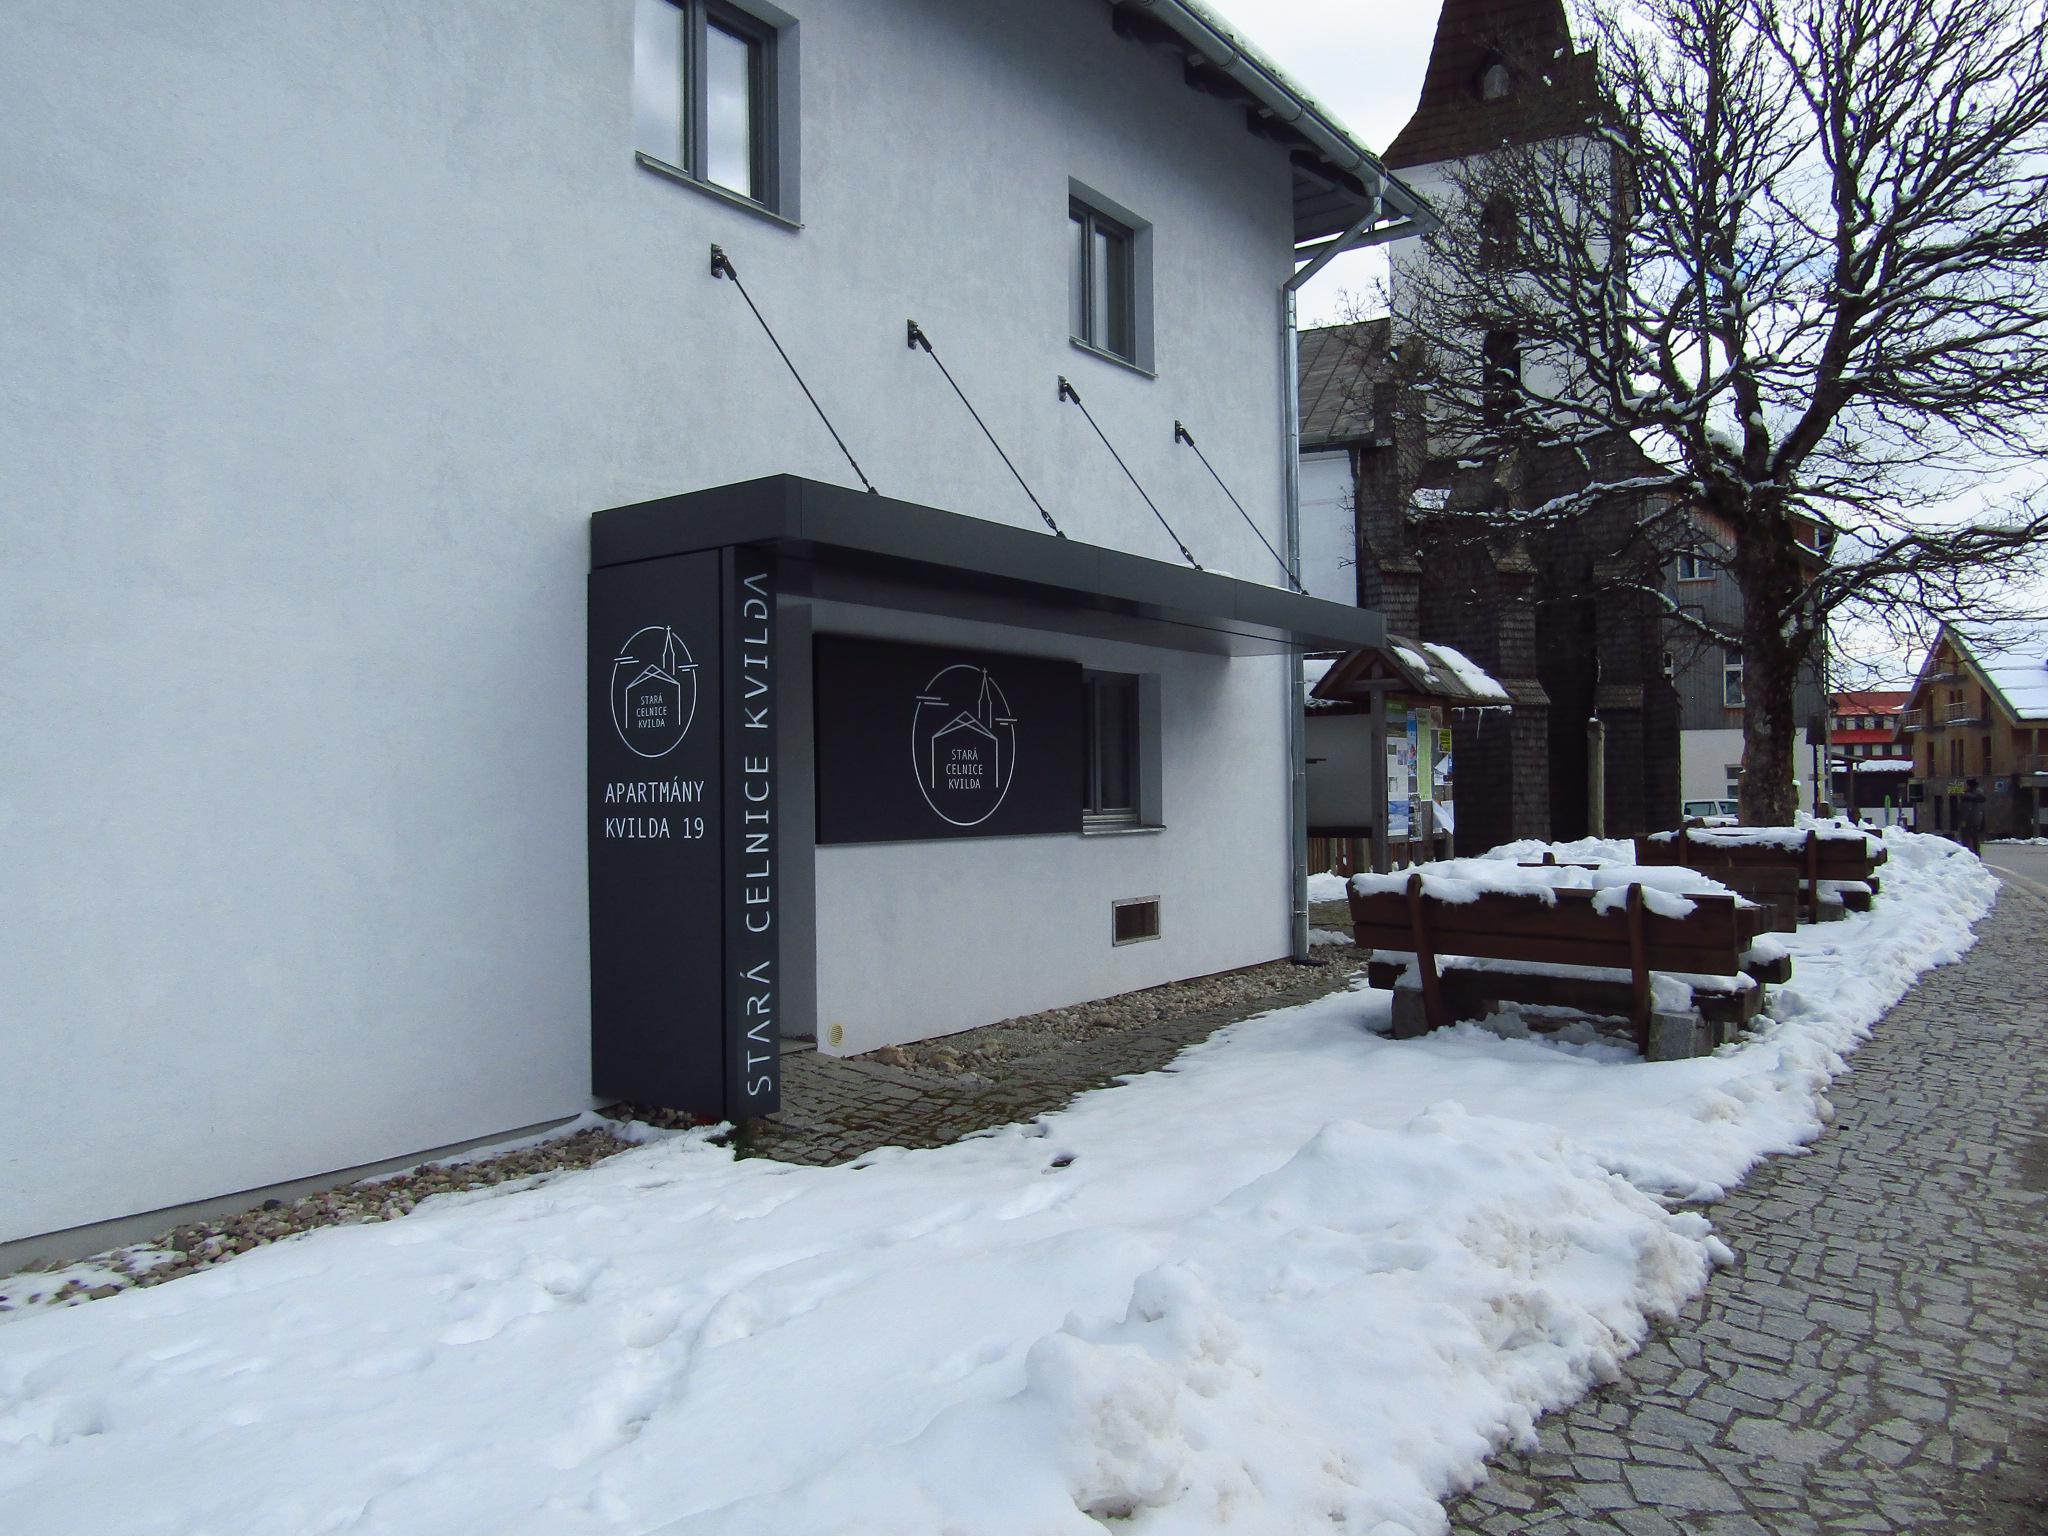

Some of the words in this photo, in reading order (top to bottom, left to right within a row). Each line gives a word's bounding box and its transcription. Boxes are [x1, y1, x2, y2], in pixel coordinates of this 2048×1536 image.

[743, 573, 769, 729] KVILDA
[640, 692, 663, 705] STARÁ
[636, 706, 668, 717] CELNICE
[638, 718, 666, 729] KVILDA
[951, 747, 979, 761] STARÁ
[945, 764, 983, 775] CELNICE
[605, 775, 704, 803] APARTMÁNY
[948, 778, 981, 790] KVILDA
[606, 817, 670, 838] KVILDA
[683, 817, 704, 839] 19
[745, 756, 771, 932] CELNICE
[740, 960, 771, 1096] STARÁ
